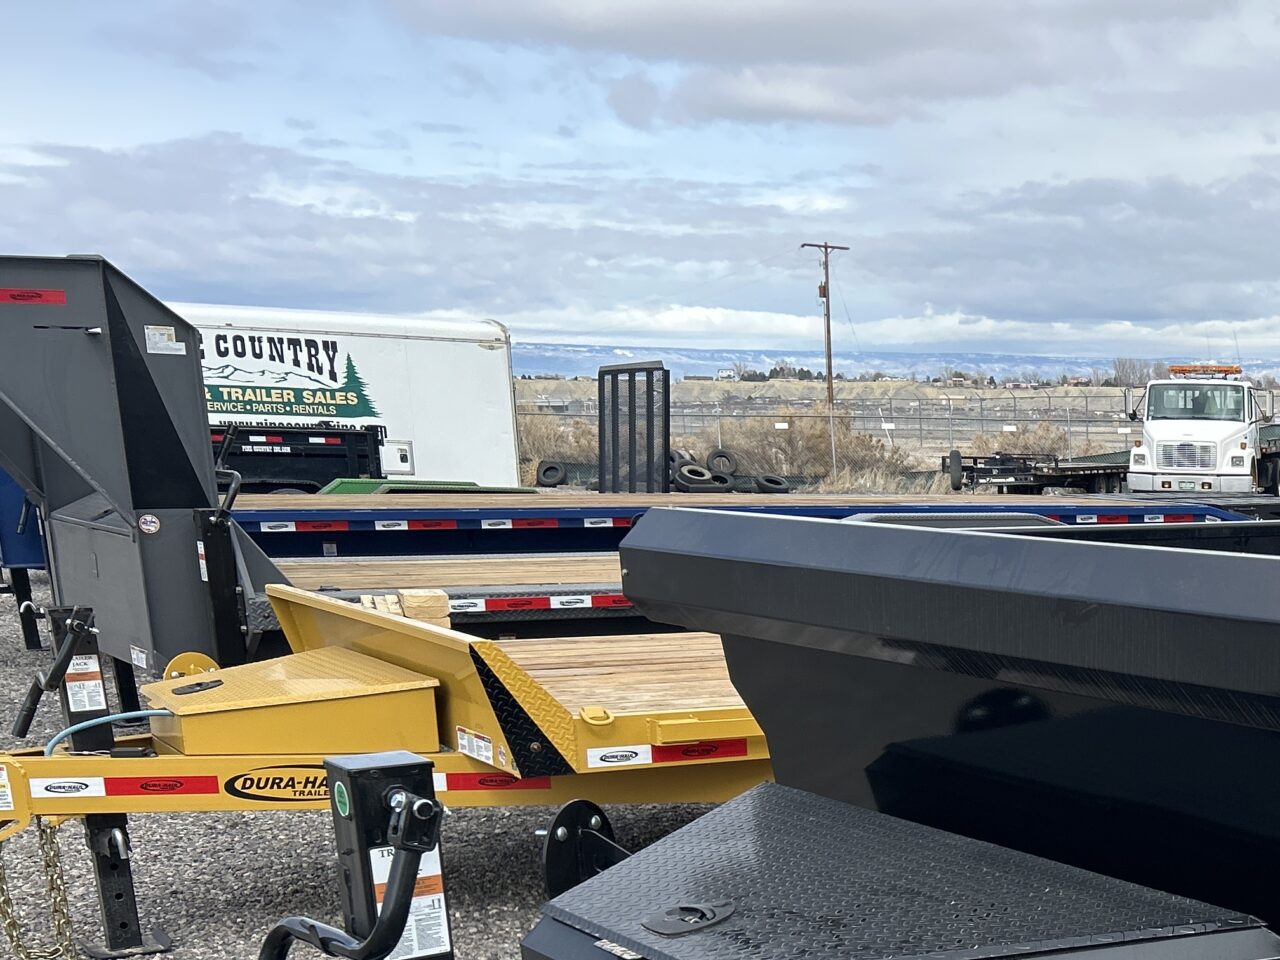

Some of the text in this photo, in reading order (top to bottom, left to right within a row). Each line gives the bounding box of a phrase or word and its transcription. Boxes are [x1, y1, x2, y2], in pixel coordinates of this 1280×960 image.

[214, 334, 339, 383] COUNTRY
[219, 387, 295, 403] TRAILER
[303, 390, 358, 405] SALES
[207, 402, 337, 415] ERVICE PARTS RENTALS
[240, 776, 328, 790] DURA-HA
[291, 789, 330, 797] TRAILE
